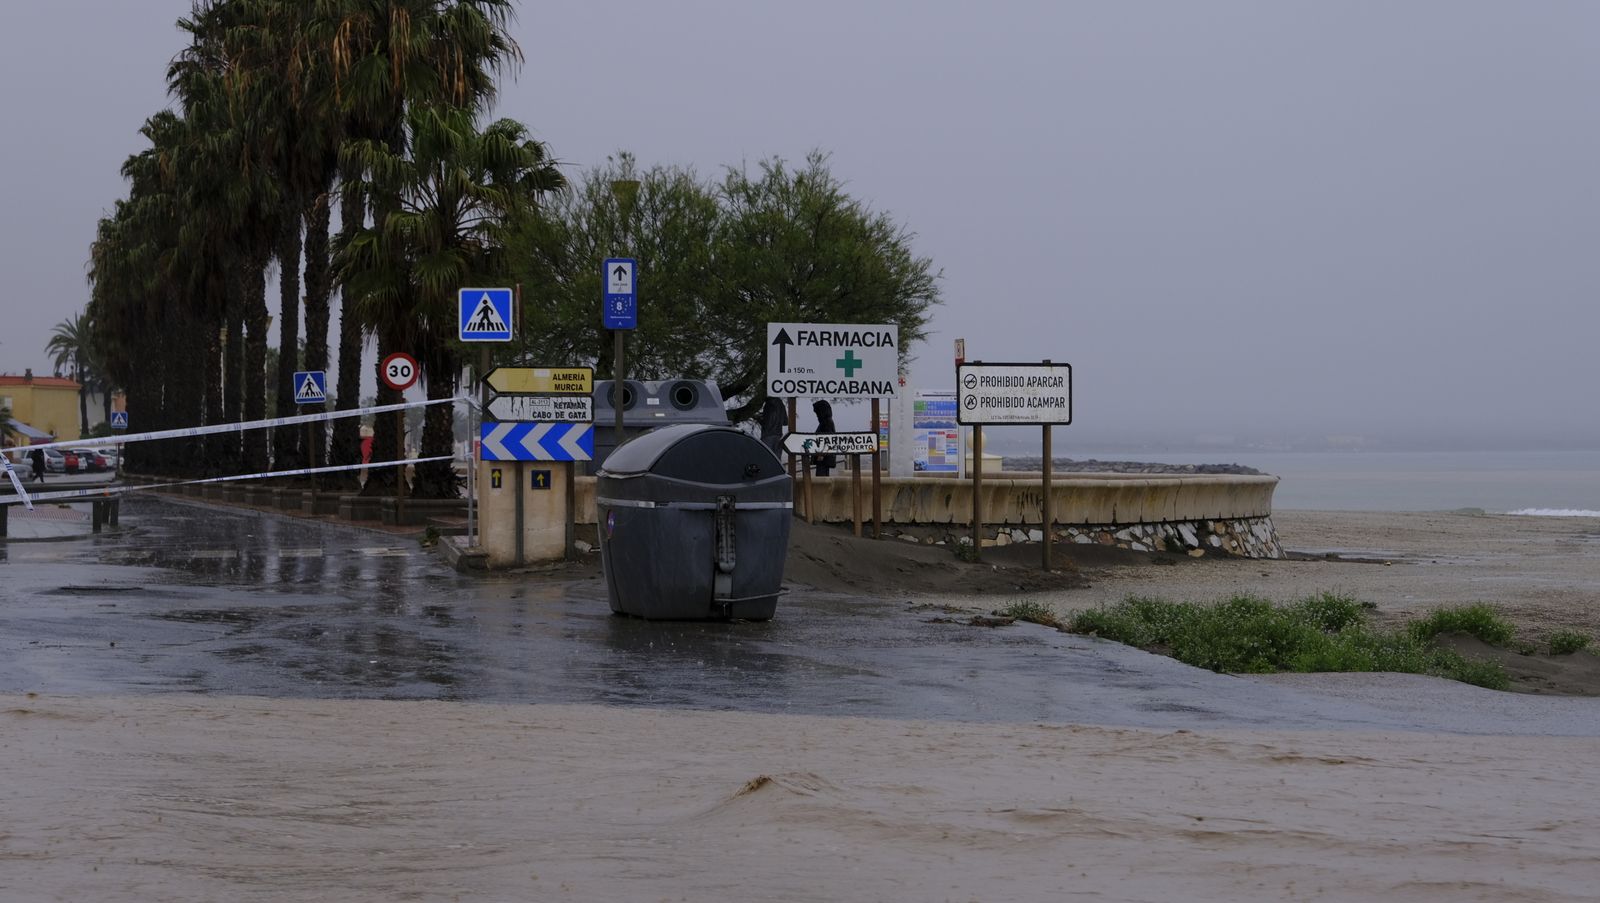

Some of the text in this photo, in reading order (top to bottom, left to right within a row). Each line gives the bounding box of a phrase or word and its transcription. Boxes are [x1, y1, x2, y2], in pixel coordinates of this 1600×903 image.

[616, 301, 623, 311] 8
[797, 331, 895, 347] FARMACIA
[389, 365, 411, 378] 30
[771, 380, 895, 395] COSTACABANA
[980, 376, 1064, 388] PROHIBIDO APARCAR
[553, 401, 587, 409] RETAMAR
[980, 396, 1065, 408] PROHIBIDO ACAMPAR
[532, 411, 587, 419] CABO DE GATA
[818, 436, 874, 445] FARMACIA
